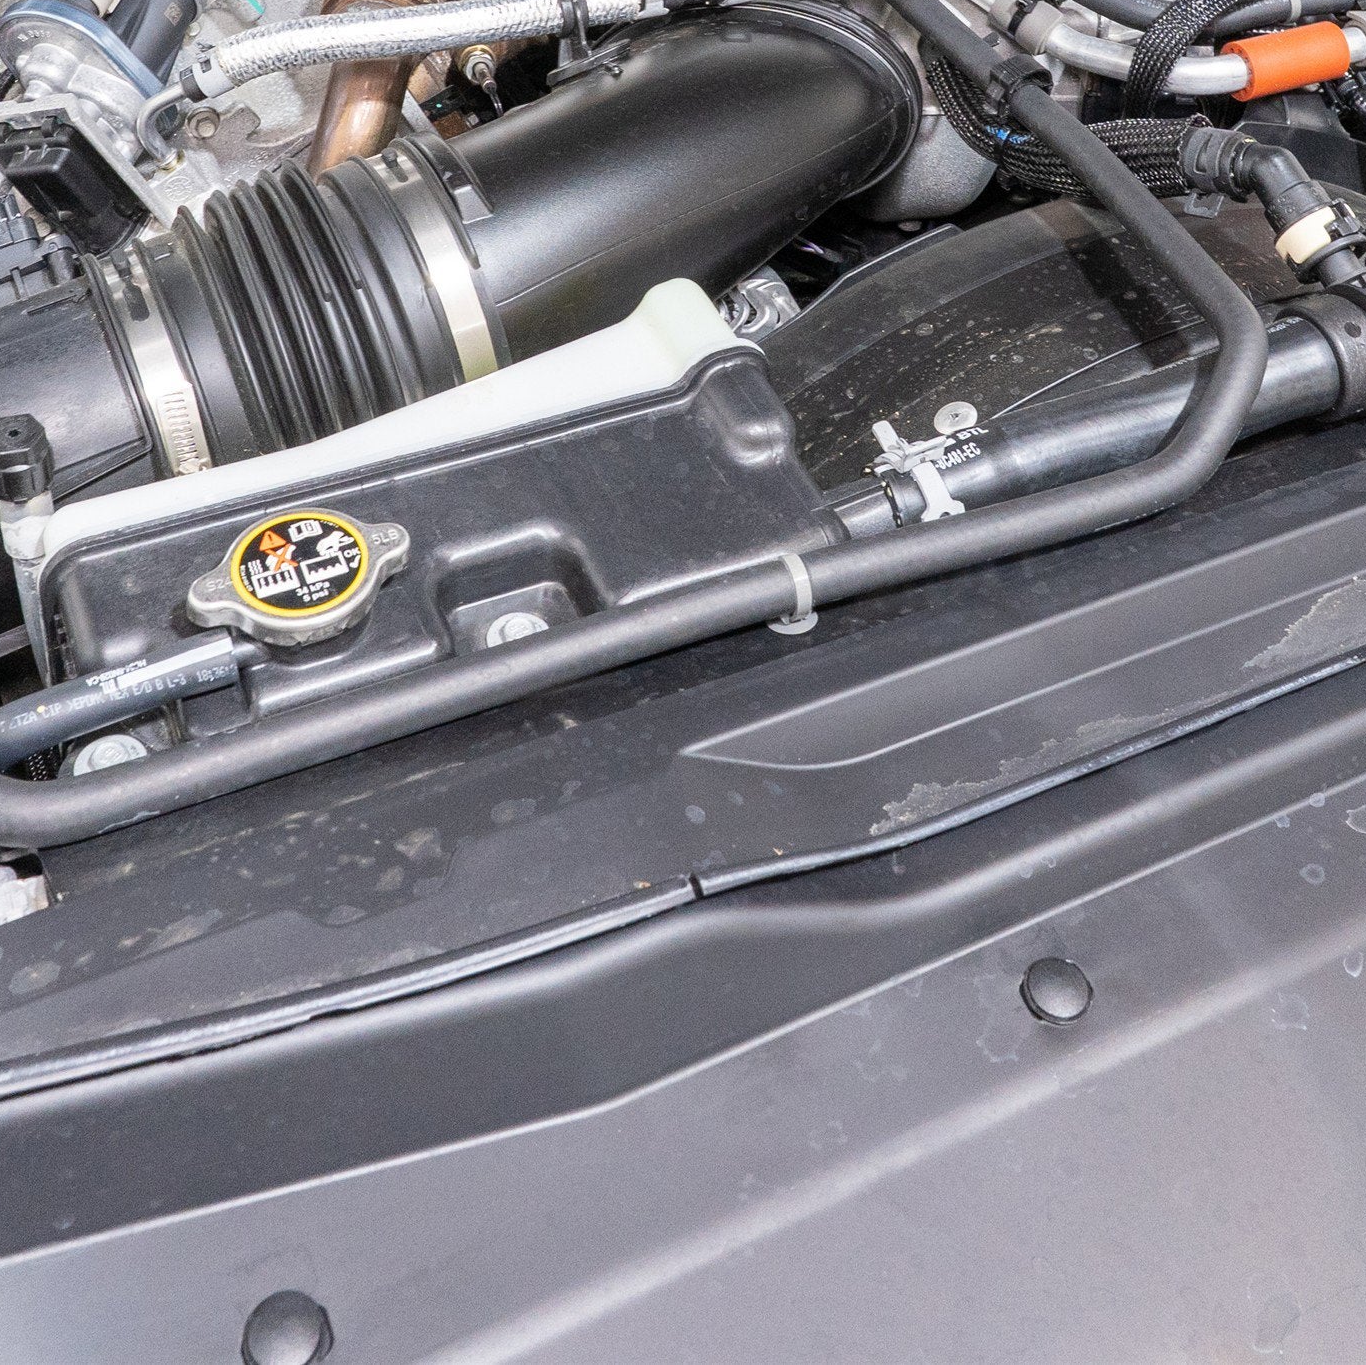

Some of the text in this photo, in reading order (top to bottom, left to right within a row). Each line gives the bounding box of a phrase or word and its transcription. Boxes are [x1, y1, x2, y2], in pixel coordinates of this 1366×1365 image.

[372, 529, 399, 545] 5LB
[344, 547, 361, 558] OK
[309, 580, 331, 593] kPa
[312, 589, 329, 602] psi
